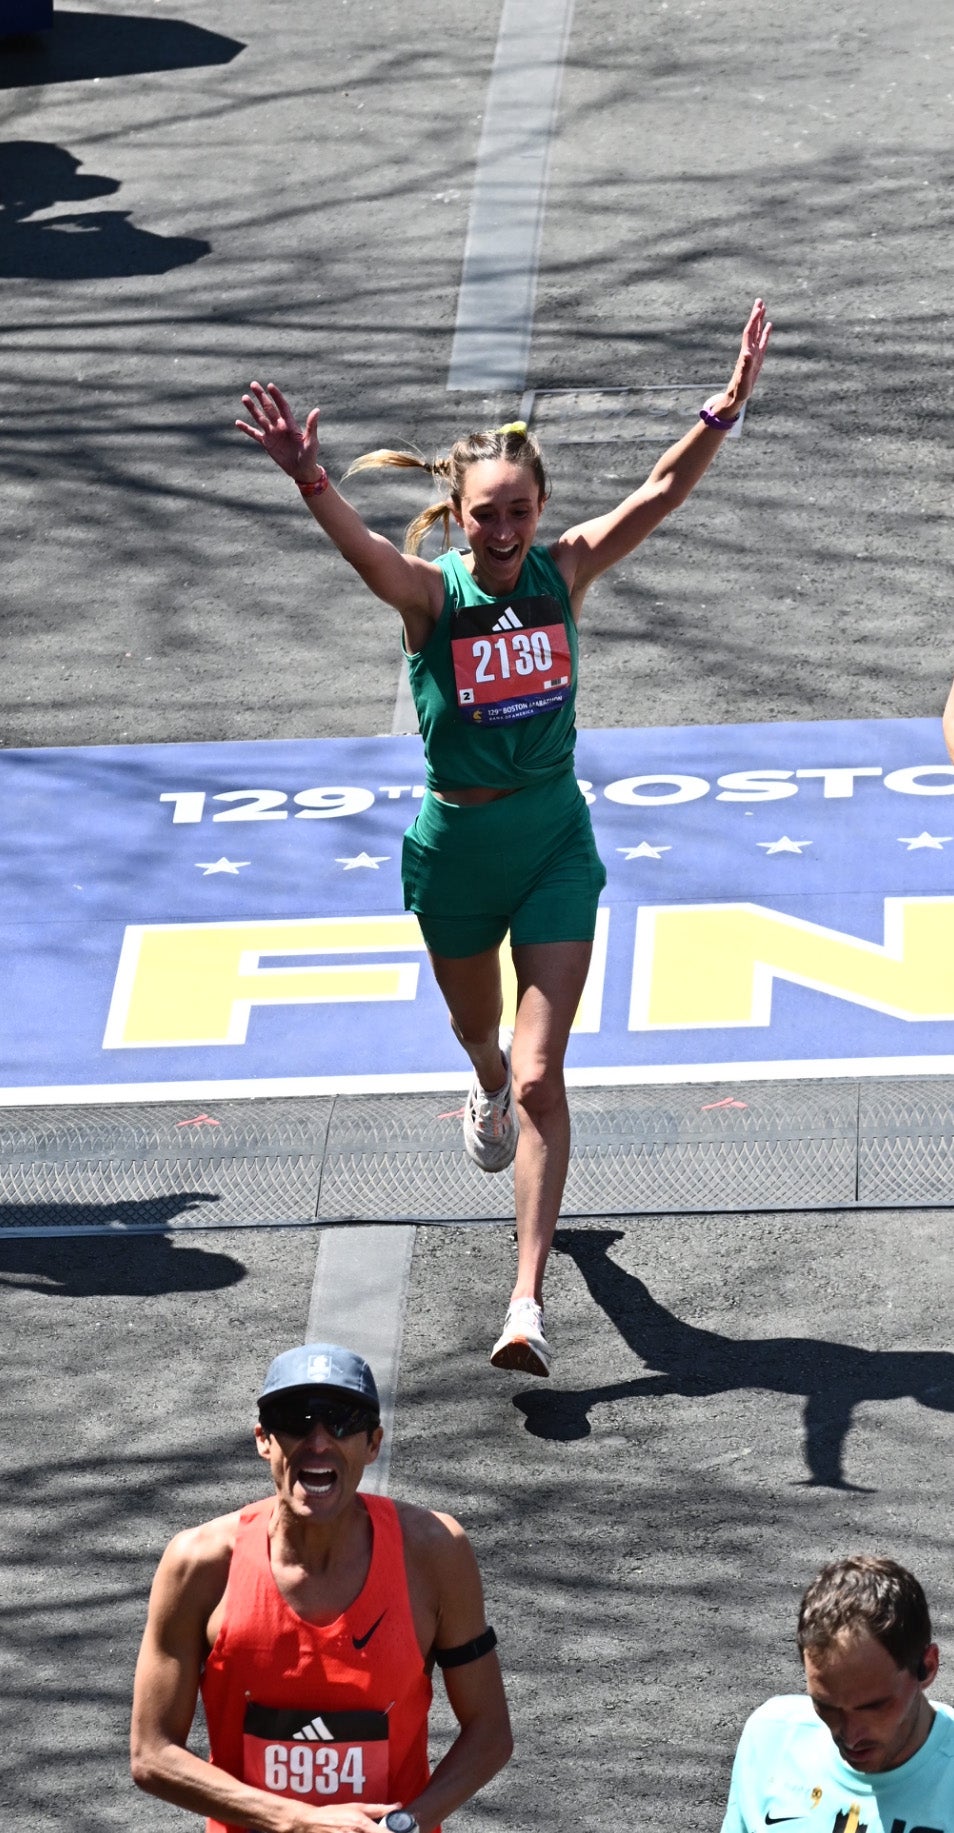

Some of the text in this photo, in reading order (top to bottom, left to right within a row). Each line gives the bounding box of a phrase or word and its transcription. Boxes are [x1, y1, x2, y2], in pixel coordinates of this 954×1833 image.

[472, 631, 553, 683] 2130
[463, 692, 471, 700] 2
[502, 702, 528, 715] BOSTON
[577, 765, 954, 806] OSTO
[264, 1744, 366, 1795] 6934
